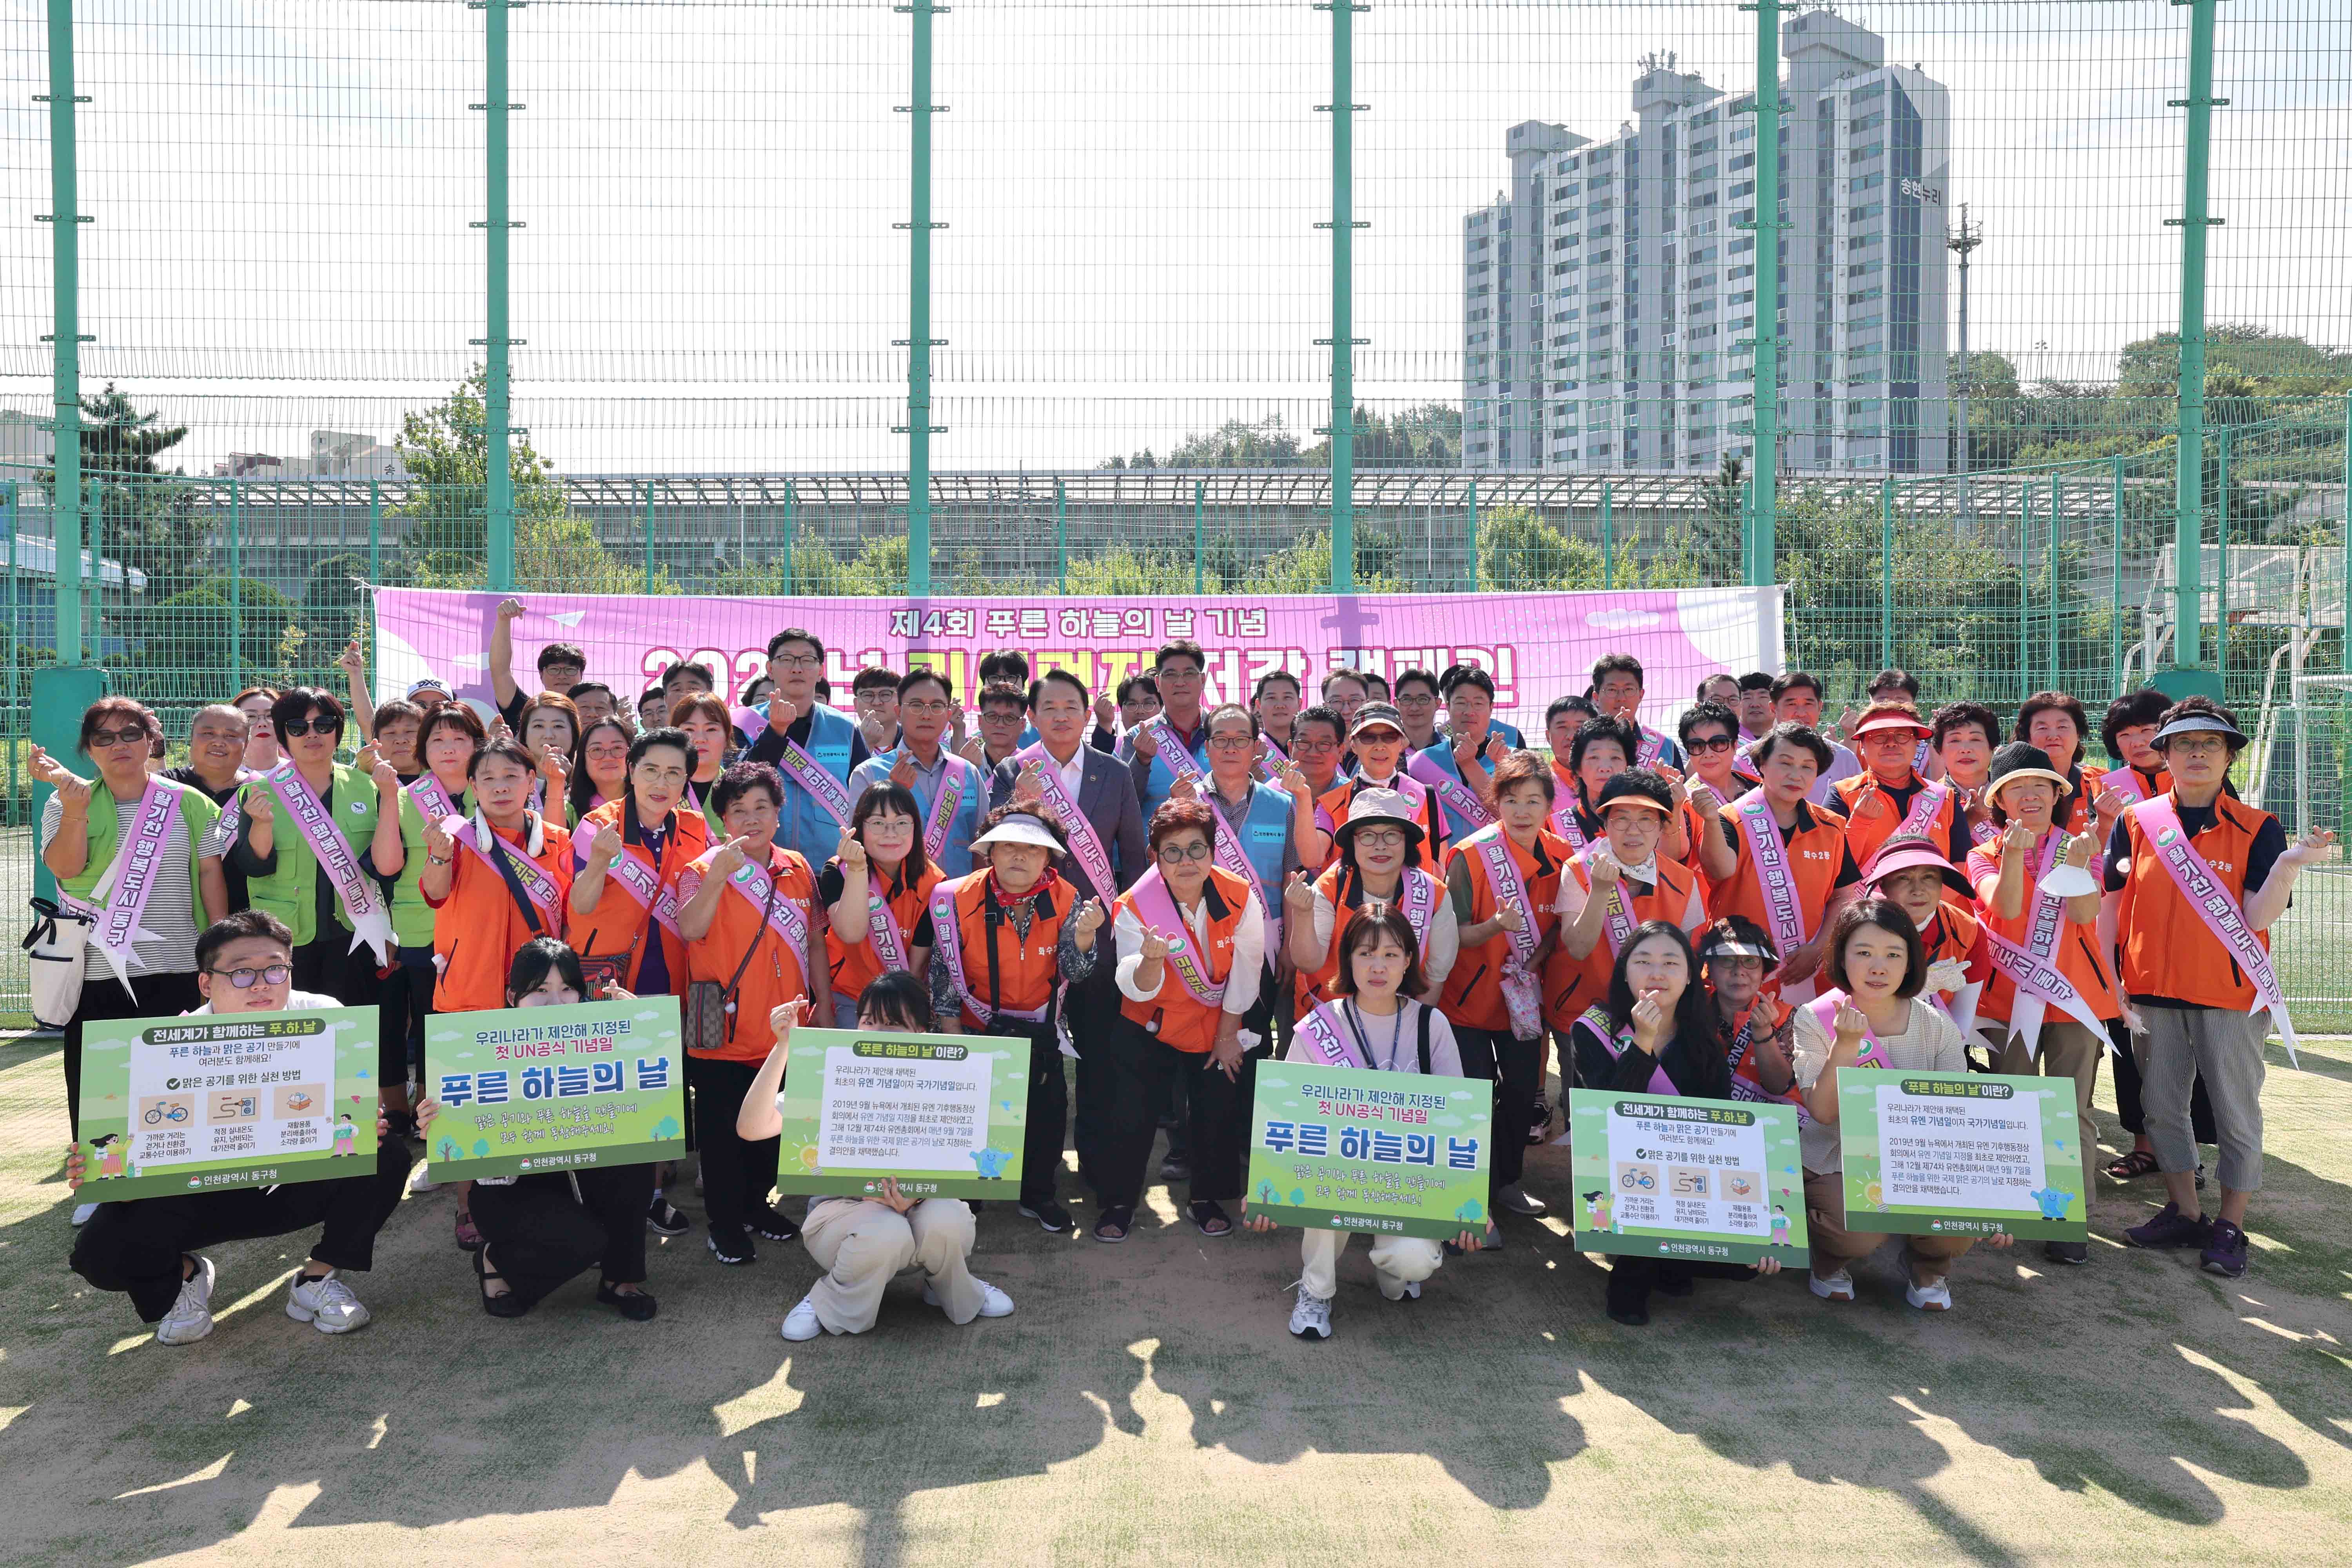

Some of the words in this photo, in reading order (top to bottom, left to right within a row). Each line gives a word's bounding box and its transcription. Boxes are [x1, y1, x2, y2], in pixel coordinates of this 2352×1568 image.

[1901, 178, 1940, 205] 송현누리
[889, 608, 975, 639] 제4회
[985, 608, 1049, 639] 푸른
[1059, 607, 1154, 639] 하늘의
[1163, 607, 1194, 638] 날
[1205, 607, 1268, 638] 기념
[641, 646, 887, 712] 202년
[143, 789, 173, 838] 활기찬
[936, 789, 957, 830] 미세먼지
[1450, 788, 1490, 824] 활기찬
[1038, 773, 1072, 819] 활기찬
[1065, 817, 1107, 877] 행복도시
[283, 779, 322, 824] 활기찬
[310, 822, 358, 885] 행복도시
[347, 882, 370, 914] 동구
[1803, 849, 1830, 860] 화수2동
[116, 839, 157, 908] 행복도시
[1487, 844, 1519, 897] 활기찬
[2206, 860, 2232, 872] 수2동
[1750, 818, 1780, 867] 활기찬
[1767, 870, 1800, 940] 행복도시
[106, 911, 132, 947] 동구
[2166, 844, 2215, 898] 활기찬
[2203, 894, 2264, 969] 행복도시
[2256, 965, 2279, 1004] 동구
[869, 914, 899, 962] 활기찬
[937, 923, 960, 977] 활기찬
[2032, 967, 2073, 1000] 동구
[154, 1027, 209, 1042] 전세계가
[212, 1024, 265, 1038] 함께하는
[269, 1020, 316, 1034] 푸.하.날
[476, 1027, 543, 1045] 우리나라가
[548, 1024, 586, 1039] 제안해
[592, 1020, 630, 1035] 지정된
[169, 1047, 189, 1058] 푸른
[192, 1045, 220, 1056] 하늘과
[223, 1044, 242, 1054] 맑은
[246, 1042, 264, 1053] 공기
[267, 1040, 299, 1051] 만들기에
[495, 1045, 509, 1060] 첫
[514, 1041, 564, 1058] UN공식
[570, 1037, 612, 1053] 기념일
[886, 1044, 918, 1056] 하늘의
[199, 1056, 232, 1066] 여러분도
[236, 1054, 271, 1064] 함께해요!
[183, 1077, 202, 1088] 맑은
[206, 1075, 234, 1086] 공기를
[238, 1073, 257, 1084] 위한
[261, 1071, 278, 1082] 실천
[283, 1070, 300, 1081] 방법
[440, 1070, 509, 1107] 푸른
[521, 1060, 624, 1100] 하늘의
[637, 1056, 668, 1090] 날
[1933, 1082, 1964, 1095] 하늘의
[1301, 1085, 1364, 1102] 우리나라가
[1368, 1091, 1404, 1105] 제안해
[1408, 1094, 1445, 1109] 지정된
[474, 1113, 495, 1131] 맑은
[500, 1111, 532, 1128] 공기와
[536, 1108, 555, 1123] 푸른
[559, 1104, 591, 1123] 하늘을
[595, 1102, 637, 1120] 만들기에
[1319, 1100, 1330, 1115] 첫
[1336, 1103, 1383, 1120] UN공식
[1388, 1107, 1426, 1124] 기념일
[1622, 1103, 1664, 1117] 전세계가
[1667, 1106, 1708, 1120] 함께하는
[1711, 1110, 1747, 1123] 푸.하.날
[1887, 1103, 1921, 1113] 우리나라가
[1922, 1105, 1943, 1114] 제안해
[1945, 1106, 1965, 1115] 채택된
[229, 1125, 253, 1134] 실내온도
[287, 1120, 310, 1129] 재활용품
[1888, 1115, 1908, 1124] 최초의
[1911, 1116, 1926, 1125] 유엔
[1929, 1116, 1965, 1127] 기념일이자
[1967, 1118, 2028, 1129] 국가기념일입니다.
[146, 1133, 165, 1142] 가까운
[229, 1134, 253, 1142] 낭비되는
[281, 1128, 317, 1138] 분리배출하여
[300, 1136, 316, 1144] 줄이기
[500, 1131, 517, 1144] 모두
[521, 1129, 545, 1143] 함께
[550, 1122, 615, 1142] 동참해주세요!
[140, 1150, 164, 1159] 교통수단
[166, 1148, 191, 1156] 이용하기
[146, 1142, 165, 1150] 걷거나
[167, 1140, 185, 1148] 친환경
[211, 1143, 235, 1152] 대기전력
[238, 1142, 255, 1150] 줄이기
[1265, 1120, 1328, 1156] 푸른
[1339, 1125, 1436, 1167] 하늘의
[1448, 1136, 1479, 1170] 날
[1889, 1138, 1913, 1146] 2019년
[1915, 1138, 1926, 1147] 9월
[1928, 1139, 1953, 1148] 뉴욕에서
[1955, 1140, 1974, 1149] 개최된
[1976, 1141, 1989, 1150] 유엔
[1991, 1142, 2029, 1152] 기후행동정상
[534, 1155, 571, 1167] 인천광역시
[574, 1152, 596, 1163] 동구청
[1890, 1149, 1915, 1158] 회의에서
[1918, 1150, 1930, 1159] 유엔
[1933, 1151, 1951, 1160] 기념일
[1953, 1152, 1973, 1161] 지정을
[1975, 1153, 1994, 1161] 최초로
[1996, 1154, 2029, 1163] 제안하였고,
[204, 1172, 247, 1185] 인천광역시
[251, 1169, 276, 1180] 동구청
[1891, 1161, 1904, 1169] 그해
[1907, 1161, 1920, 1170] 12월
[1922, 1162, 1944, 1171] 제74차
[1946, 1163, 1984, 1173] 유엔총회에서
[1986, 1165, 1999, 1173] 매년
[2001, 1166, 2011, 1174] 9월
[2013, 1166, 2031, 1175] 7일을
[1891, 1172, 1904, 1181] 푸른
[1906, 1172, 1926, 1182] 하늘을
[1927, 1174, 1940, 1182] 위한
[1942, 1174, 1954, 1183] 국제
[1956, 1175, 1969, 1184] 맑은
[1971, 1176, 1989, 1185] 공기의
[1991, 1177, 2004, 1185] 날로
[2006, 1178, 2031, 1187] 지정하는
[1892, 1183, 1918, 1193] 결의안을
[1920, 1185, 1961, 1195] 채택했습니다.
[1944, 1221, 1979, 1231] 인천광역시
[1982, 1223, 2003, 1232] 동구청
